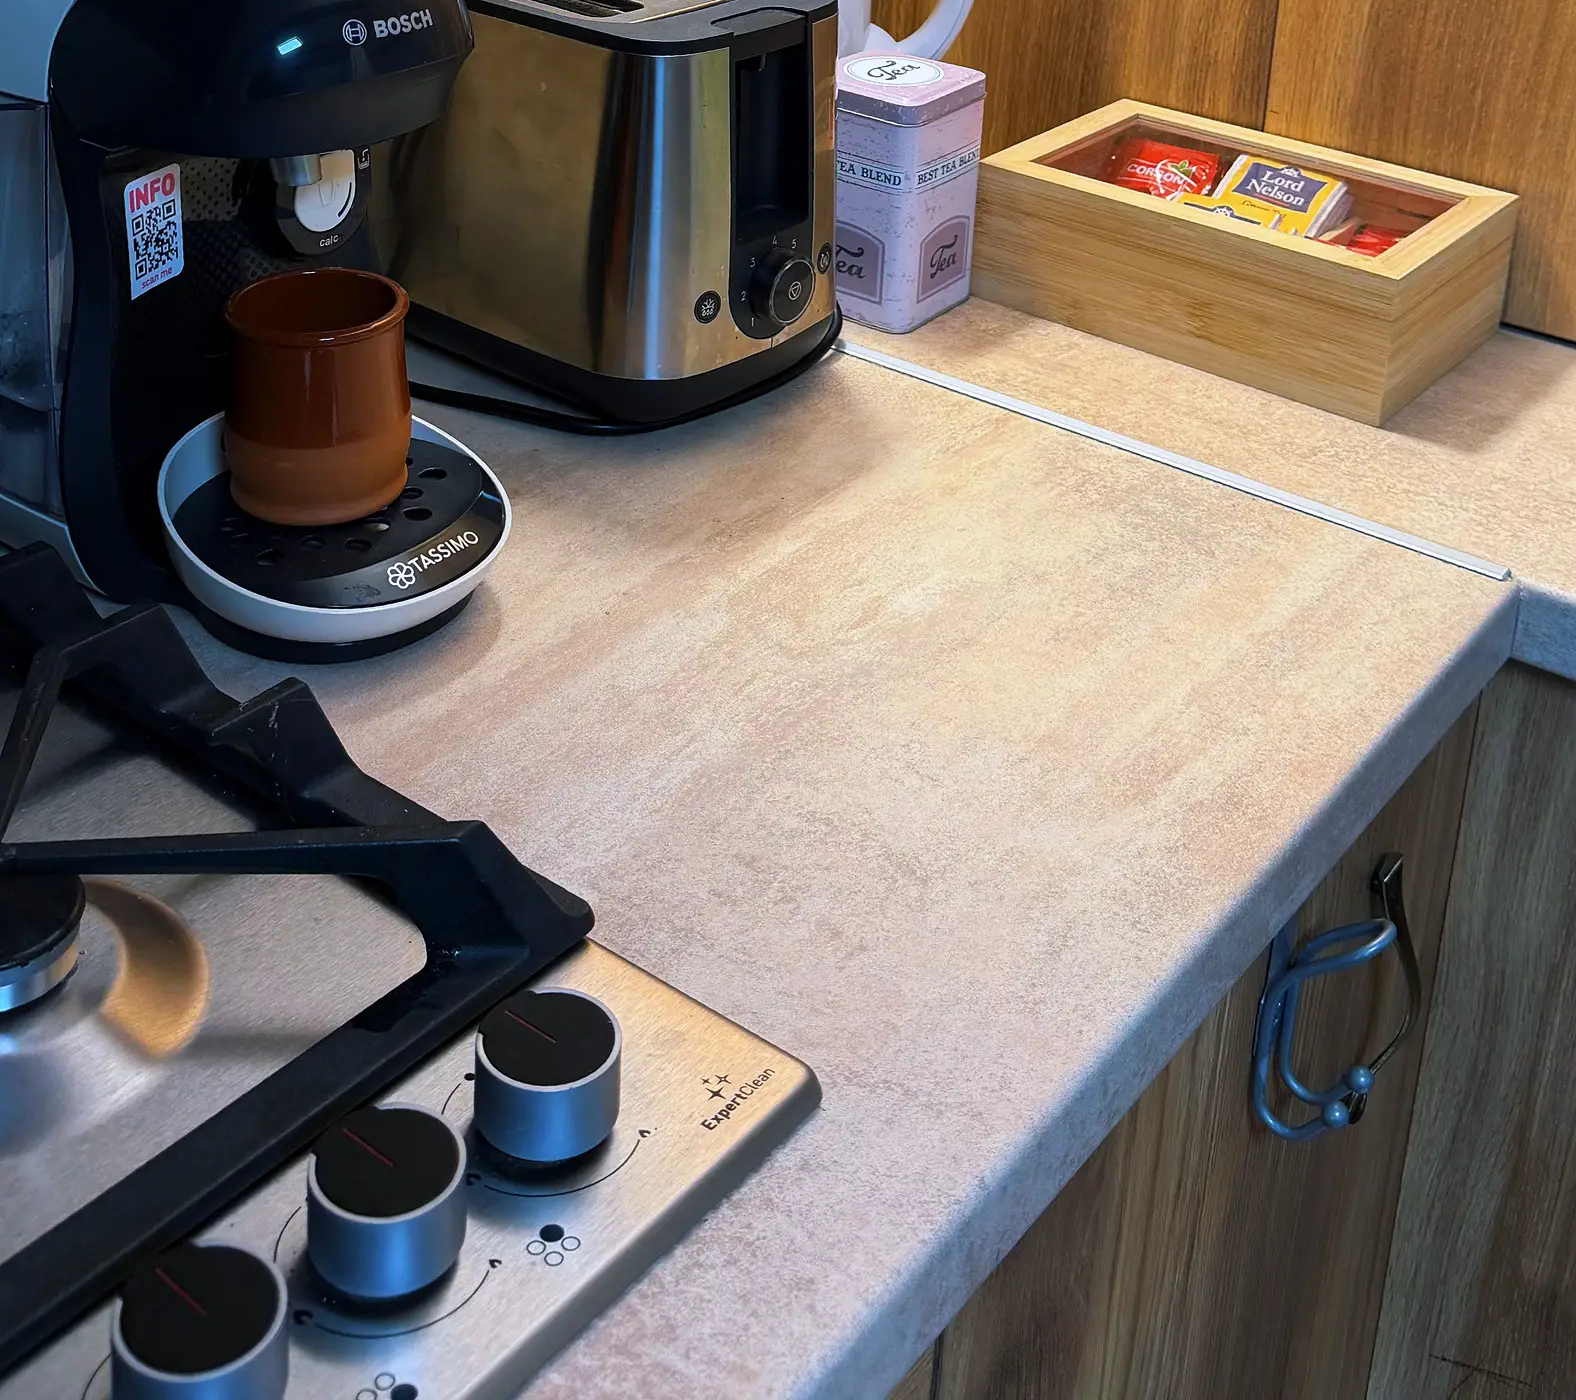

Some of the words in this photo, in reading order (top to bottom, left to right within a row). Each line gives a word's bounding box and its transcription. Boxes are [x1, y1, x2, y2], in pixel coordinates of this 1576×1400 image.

[373, 8, 433, 38] BOSCH
[867, 60, 920, 81] Tea
[861, 167, 902, 186] BLEND
[917, 168, 939, 185] BEST
[941, 160, 957, 175] TEA
[1260, 170, 1305, 193] Lord
[128, 172, 175, 213] INFO
[1248, 179, 1305, 207] Nelson
[320, 235, 339, 247] calc
[792, 238, 797, 249] 5
[930, 234, 958, 279] Tea
[142, 273, 159, 289] scan
[160, 267, 172, 278] me
[741, 291, 747, 301] 2
[408, 531, 479, 572] TASSIMO
[700, 1068, 776, 1131] ExpertClean
